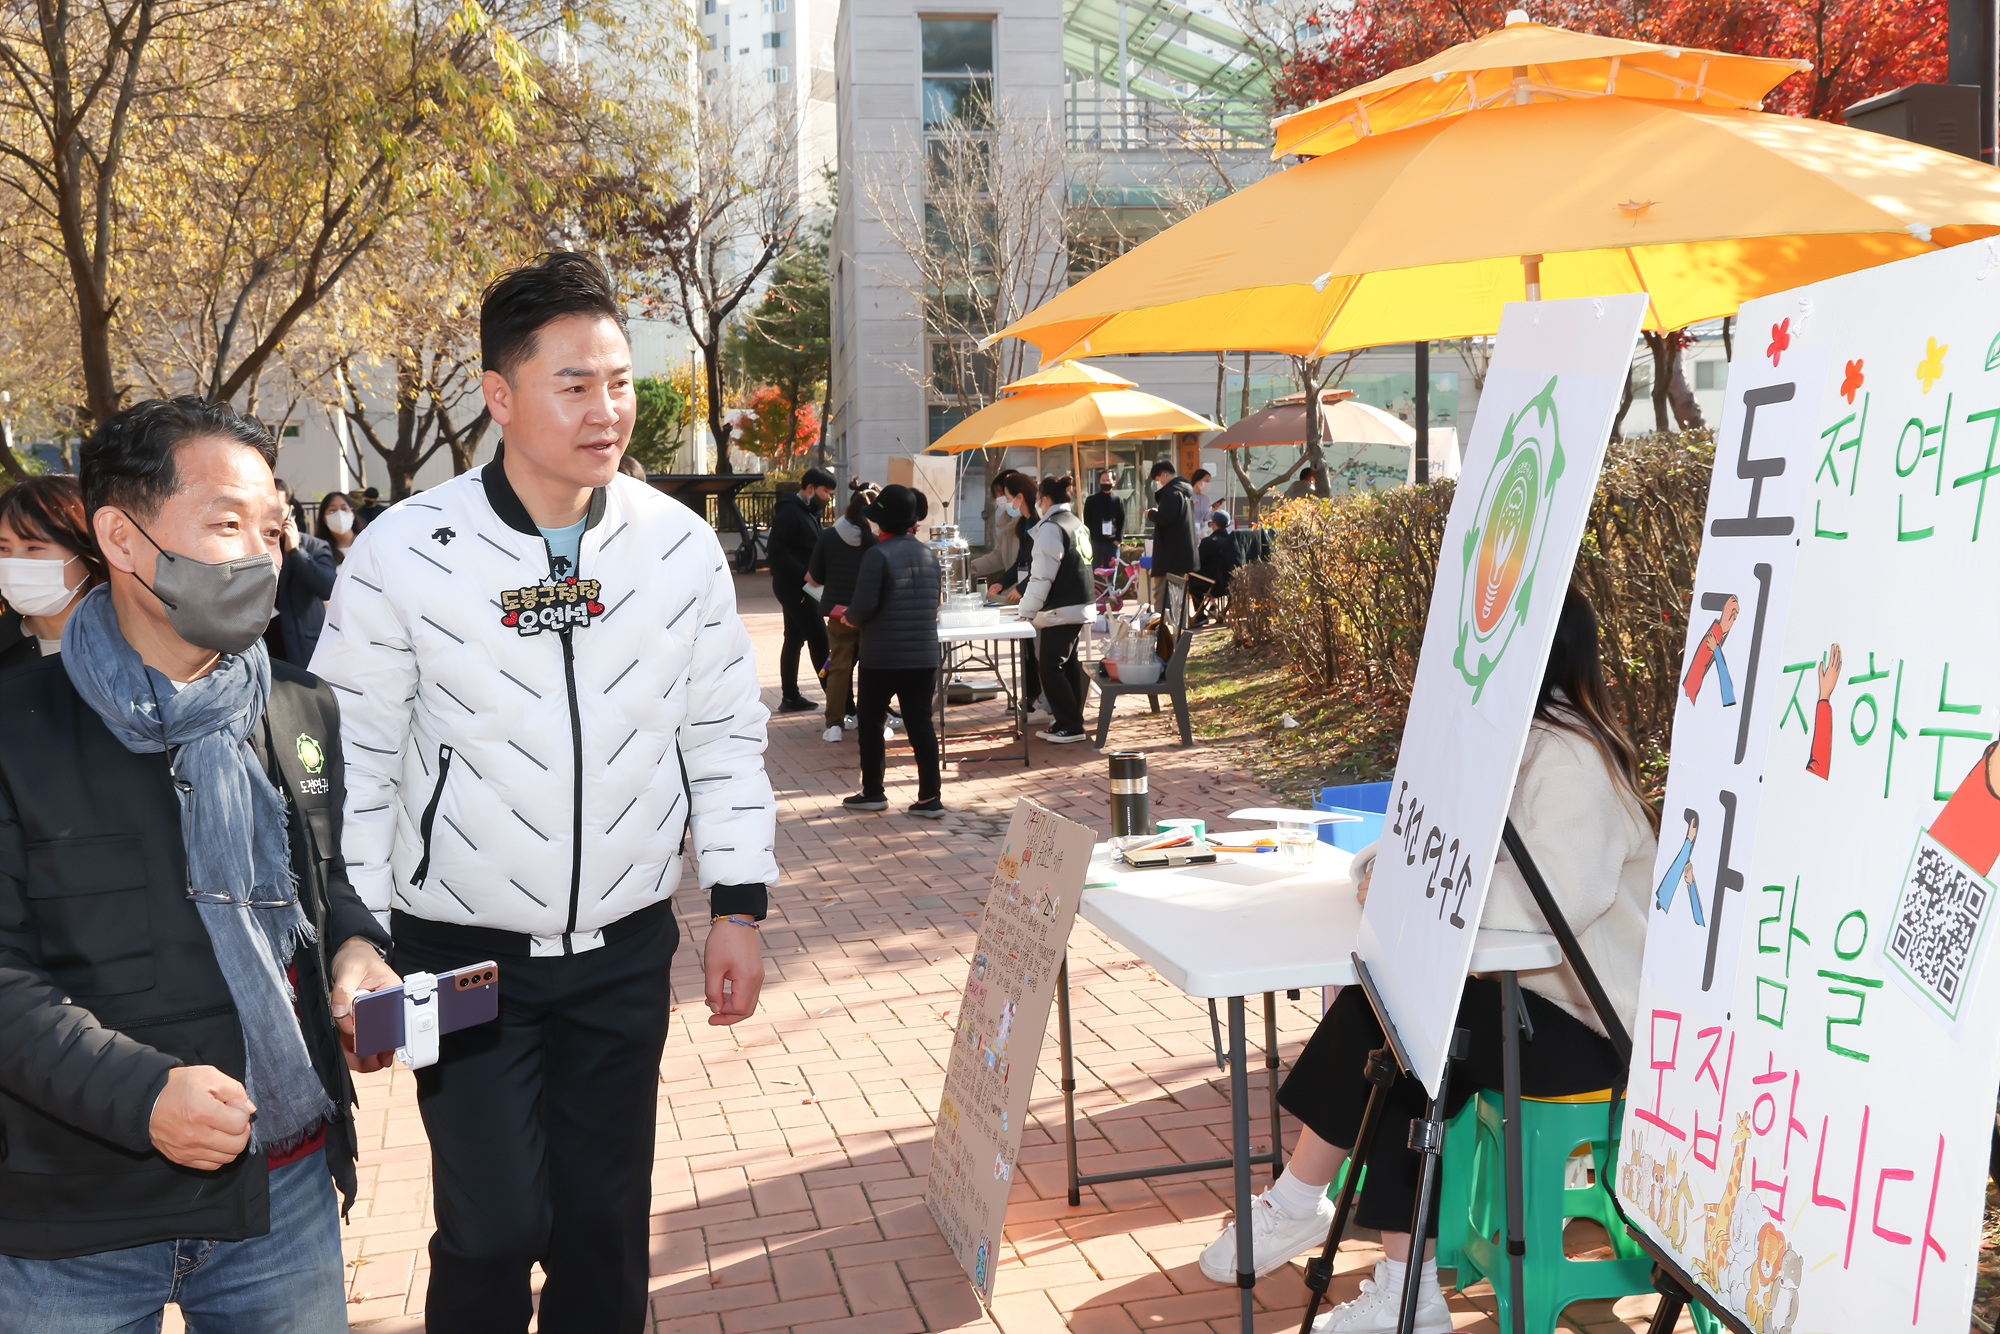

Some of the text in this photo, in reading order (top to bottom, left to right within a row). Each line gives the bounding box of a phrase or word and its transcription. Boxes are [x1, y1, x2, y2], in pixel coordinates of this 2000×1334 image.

[502, 580, 599, 611] 도봉구청장
[518, 602, 588, 634] 오언석
[1635, 1009, 1947, 1326] 모집합니다
